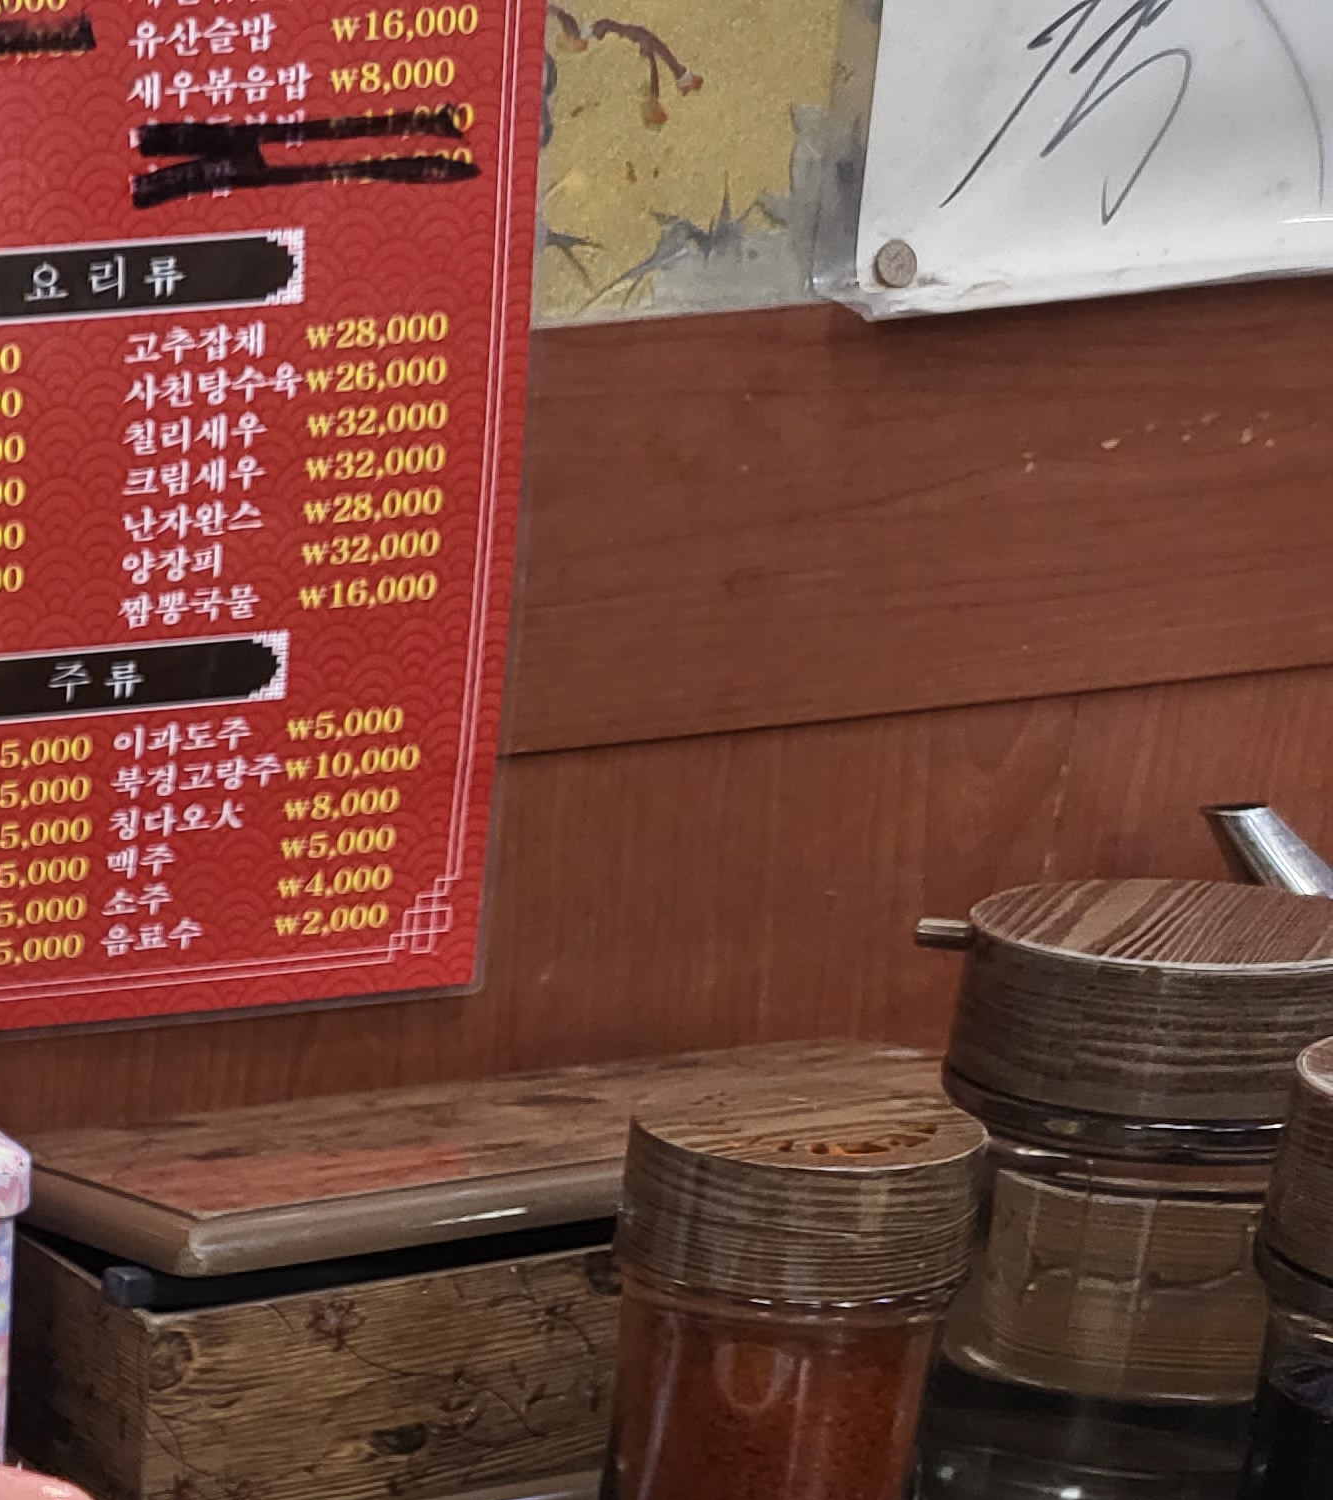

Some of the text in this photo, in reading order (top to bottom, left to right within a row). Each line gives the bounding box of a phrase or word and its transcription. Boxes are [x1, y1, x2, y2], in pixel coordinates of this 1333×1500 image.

[129, 13, 277, 60] 유산슬밥
[126, 61, 312, 110] 새우볶음밥
[123, 319, 268, 364] 고추잡채
[122, 361, 304, 411] 사천탕수육
[122, 411, 268, 455] 칠리새우
[121, 455, 267, 497] 크림새우
[121, 500, 264, 542] 난자완스
[121, 541, 223, 584] 양장피
[118, 583, 260, 629] 짬뽕국물
[113, 715, 253, 760] 이과도주
[110, 753, 283, 799] 북경고량주
[106, 842, 176, 879] 맥주
[101, 881, 172, 916] 소주
[101, 916, 203, 957] 음료수
